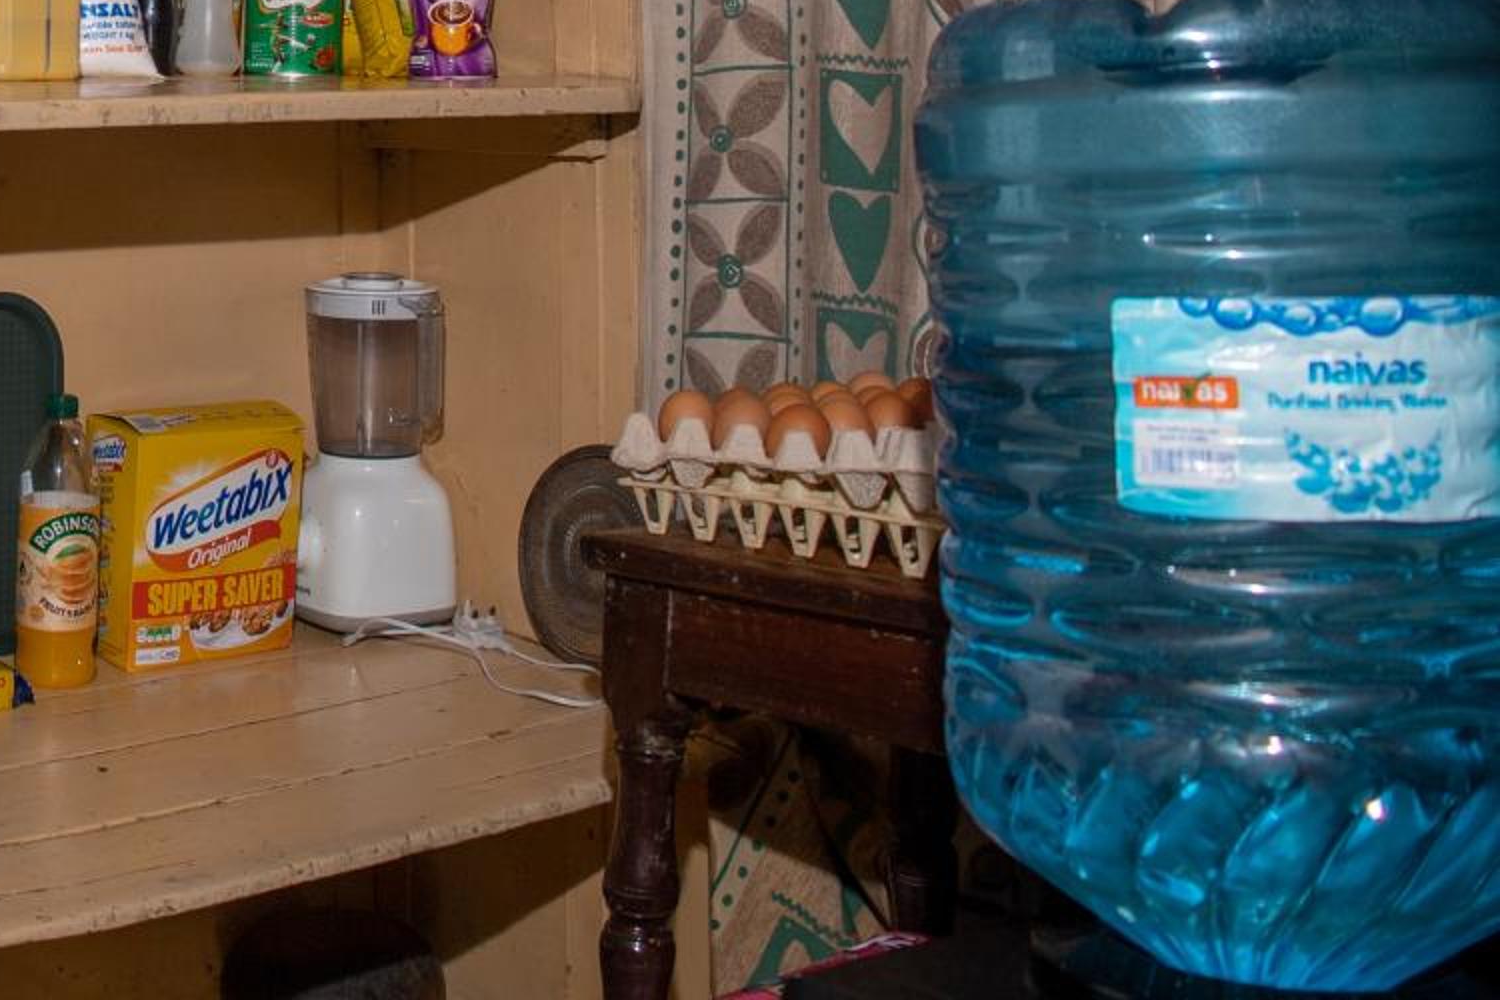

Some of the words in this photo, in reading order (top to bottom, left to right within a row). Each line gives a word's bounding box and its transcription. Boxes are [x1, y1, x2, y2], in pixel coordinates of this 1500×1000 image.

[1308, 352, 1427, 386] naivas
[1142, 380, 1228, 403] naivas
[1267, 391, 1331, 409] Purified
[1337, 392, 1397, 413] Drinking
[1402, 393, 1447, 409] Water
[153, 460, 294, 549] Weetabix
[187, 528, 251, 569] Original
[148, 578, 217, 616] SUPER
[223, 569, 285, 608] SAVER
